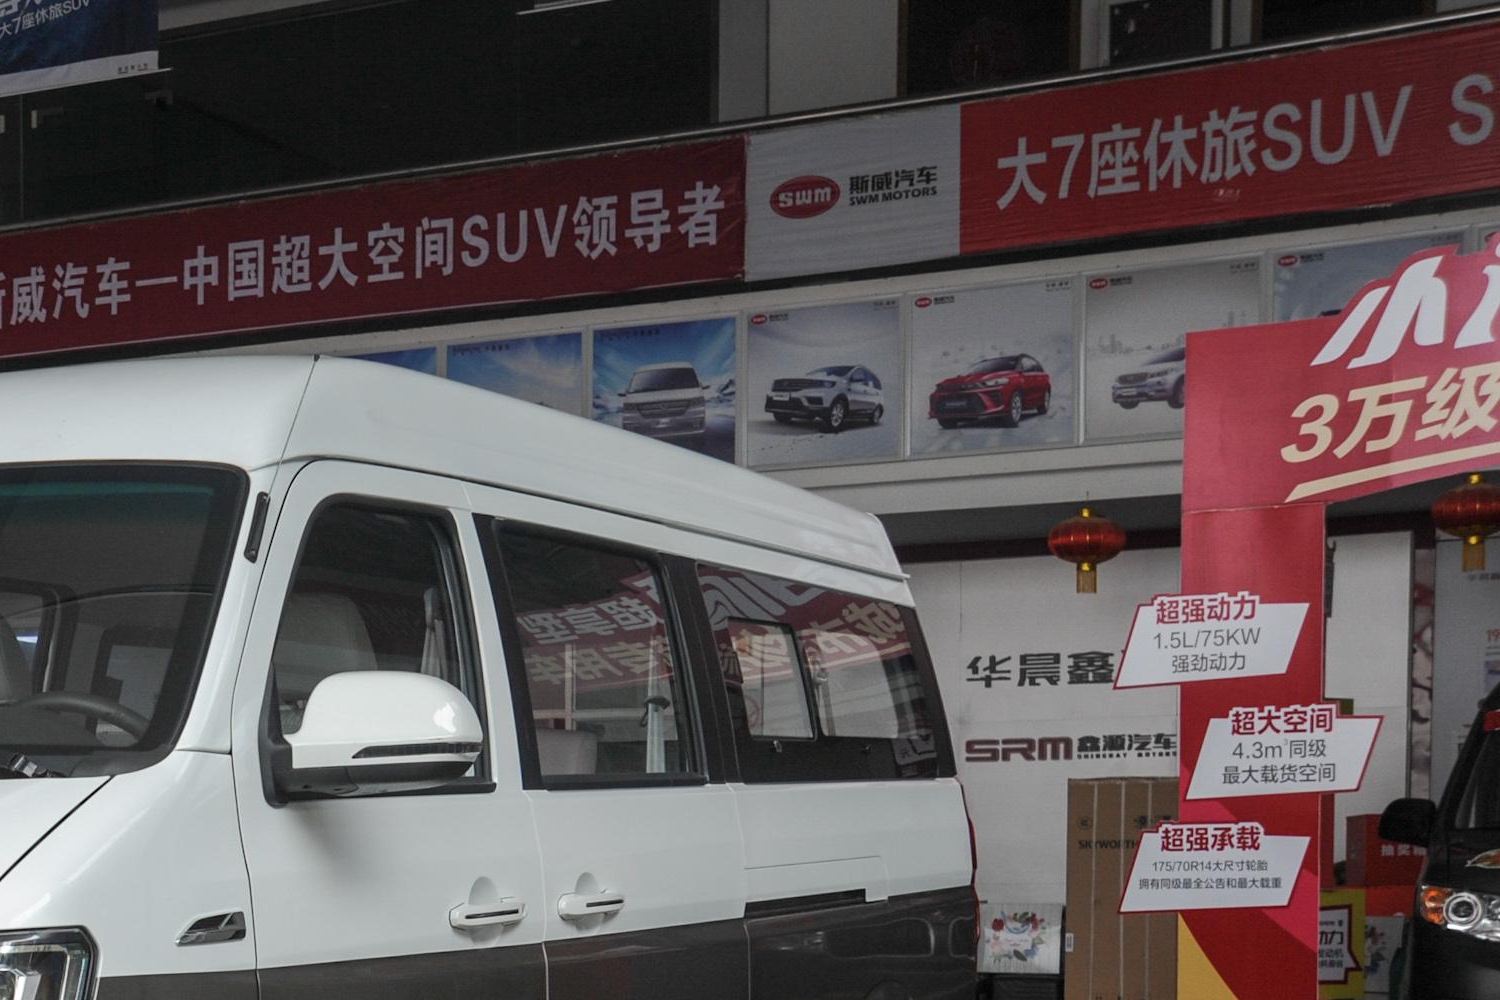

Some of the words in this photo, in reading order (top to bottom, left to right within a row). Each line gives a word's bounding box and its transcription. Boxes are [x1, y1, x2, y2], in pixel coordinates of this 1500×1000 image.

[996, 86, 1412, 210] 大7座休旅SUV
[848, 164, 938, 195] 斯威汽车
[778, 186, 832, 209] SWM
[848, 193, 880, 207] SWM
[882, 184, 938, 203] MOTORS
[1280, 361, 1500, 465] 3万级
[1156, 596, 1258, 625] 超强动力
[1153, 627, 1261, 650] 1.5L/75KW
[965, 650, 1125, 688] 华晨鑫
[1171, 653, 1246, 674] 强劲动力
[1230, 707, 1334, 736] 超大空间
[965, 736, 1073, 762] SRM
[1076, 732, 1177, 752] 鑫源汽车
[1221, 763, 1337, 785] 最大载货空间
[1160, 826, 1262, 852] 超强承载
[1152, 858, 1269, 873] 175/70R14大尺寸轮胎
